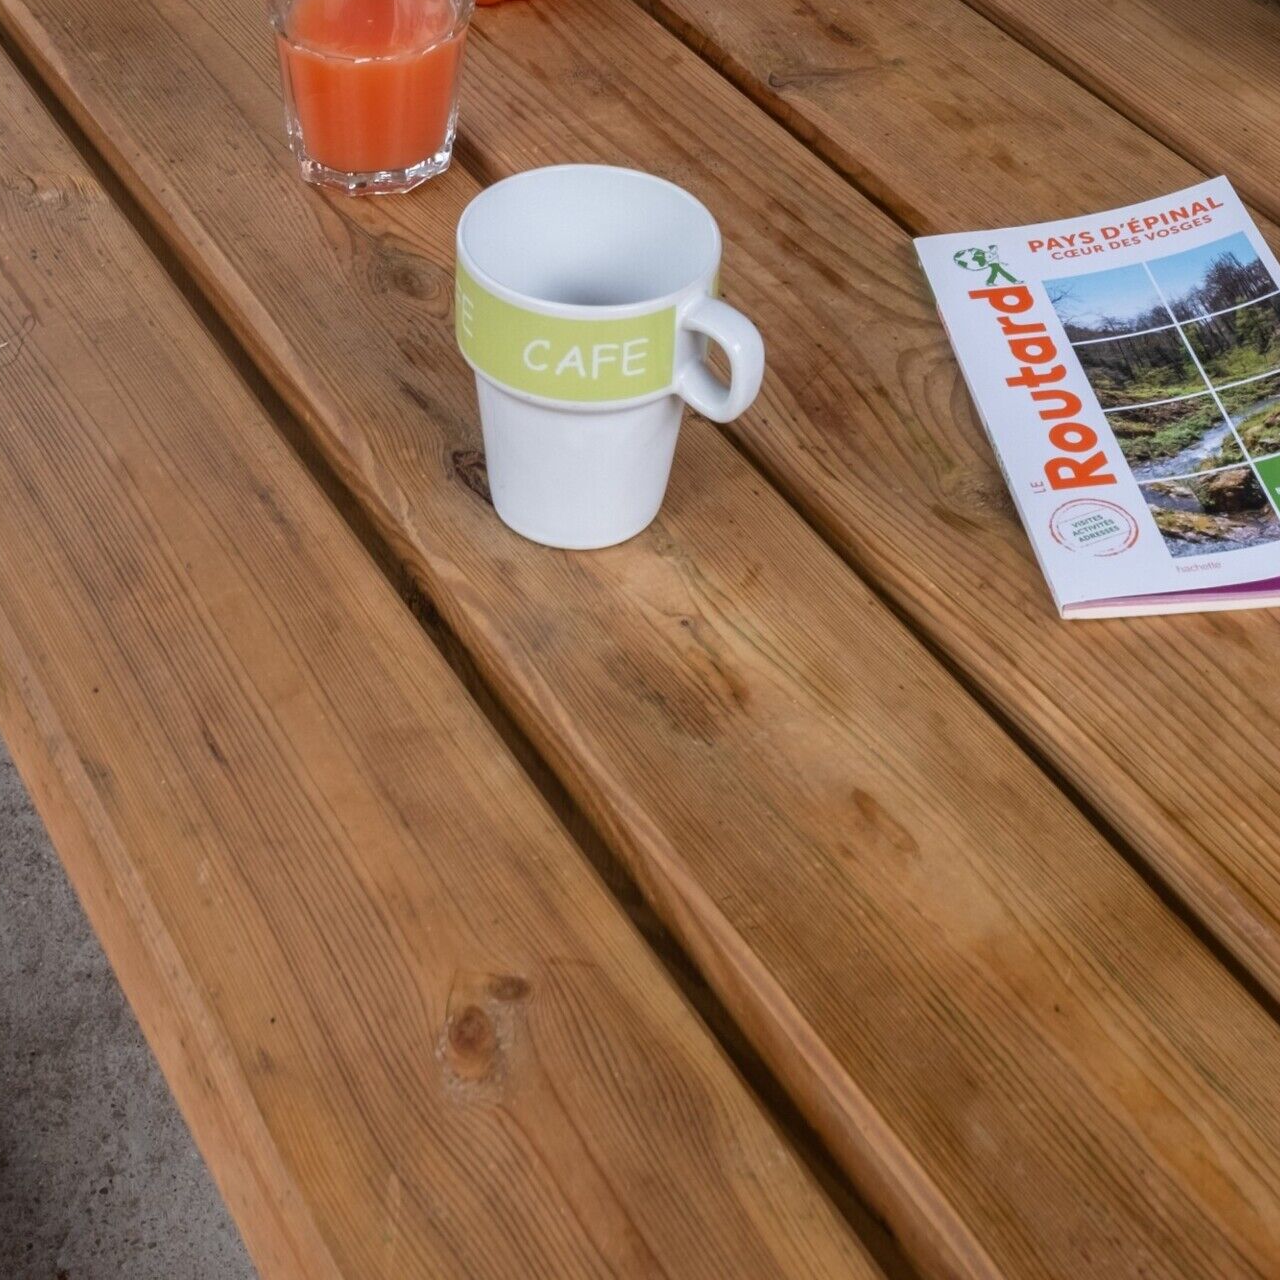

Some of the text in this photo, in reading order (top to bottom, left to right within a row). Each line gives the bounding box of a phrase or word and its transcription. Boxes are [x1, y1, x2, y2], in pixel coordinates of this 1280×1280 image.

[1027, 196, 1224, 253] PAYS D'ÉPINAL
[1051, 214, 1213, 261] CŒUR DES VOSGES
[523, 337, 649, 380] CAFE
[968, 285, 1118, 494] LE Routard
[1072, 514, 1103, 528] VISITES
[1079, 525, 1120, 542] ADRESSES
